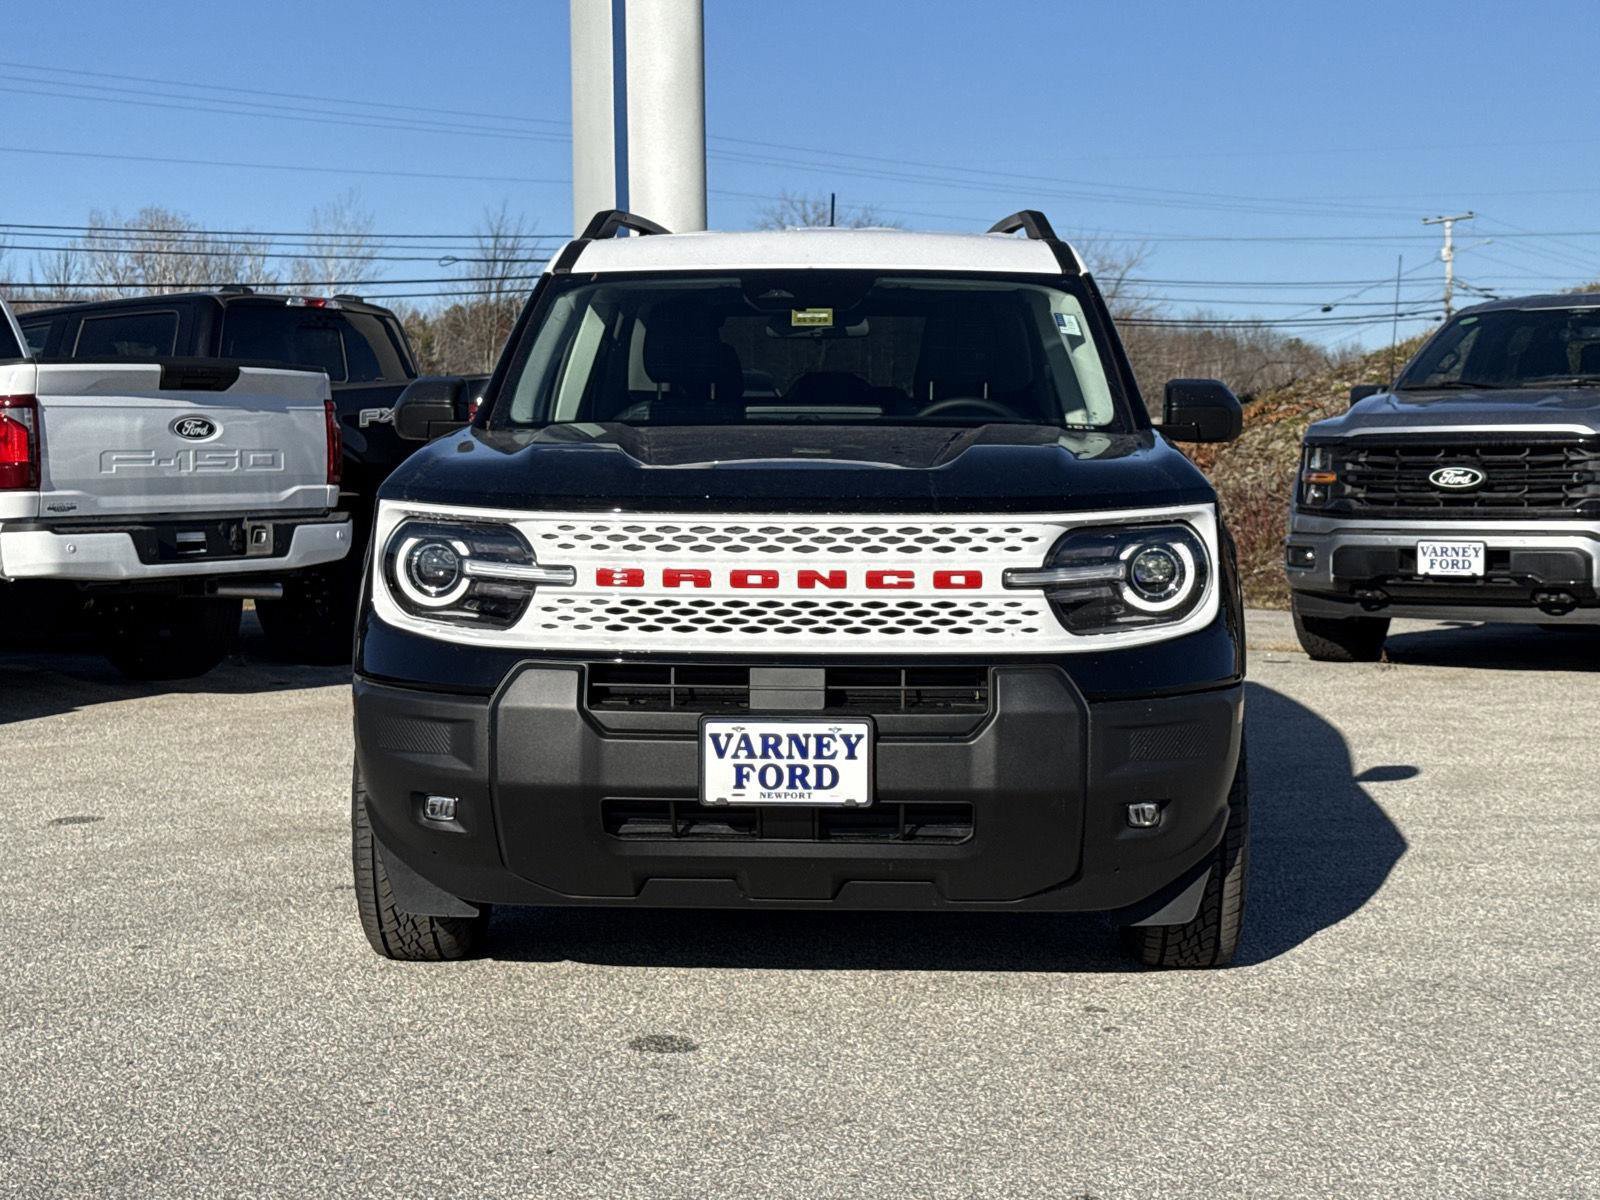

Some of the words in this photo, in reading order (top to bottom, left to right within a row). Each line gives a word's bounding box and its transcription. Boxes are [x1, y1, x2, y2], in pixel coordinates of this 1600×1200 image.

[181, 419, 209, 436] Ford
[99, 449, 285, 474] F-150
[1438, 469, 1473, 485] Ford
[1420, 546, 1482, 558] VARNEY
[1429, 558, 1472, 570] FORD
[595, 567, 983, 590] BRONCO
[708, 732, 865, 761] VARNEY
[732, 763, 840, 791] FORD
[759, 791, 813, 800] NEWPORT
